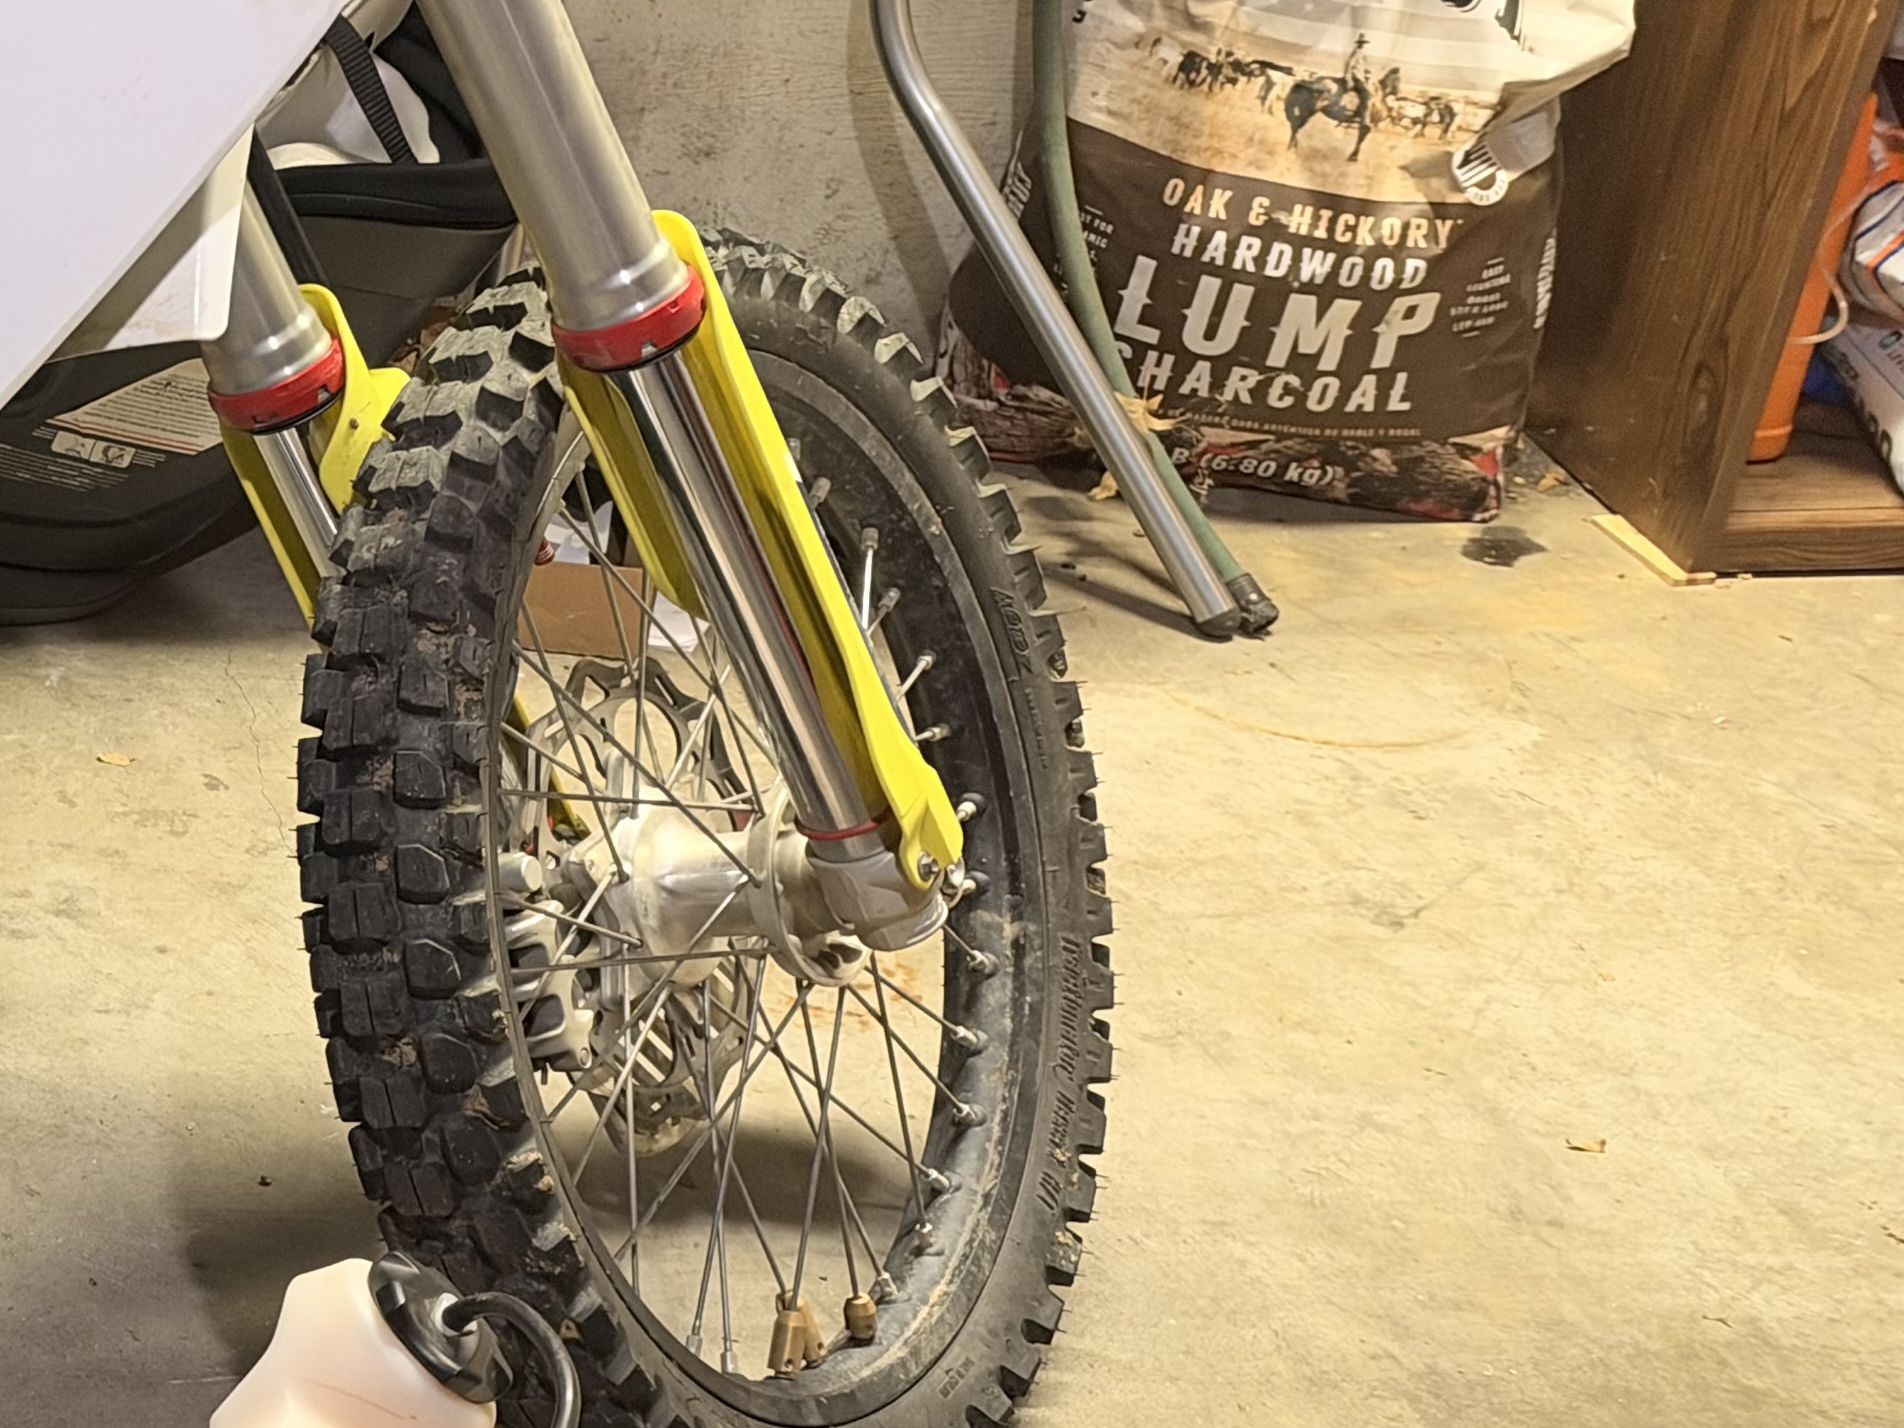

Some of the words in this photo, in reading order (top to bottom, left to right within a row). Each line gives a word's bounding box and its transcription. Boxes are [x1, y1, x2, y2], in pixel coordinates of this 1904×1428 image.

[1162, 177, 1234, 221] OAK
[1248, 196, 1271, 226] &
[1288, 203, 1456, 250] HICKORY
[1170, 223, 1428, 291] HARDWOOD
[1112, 254, 1442, 372] LUMP
[1283, 461, 1335, 487] kg)
